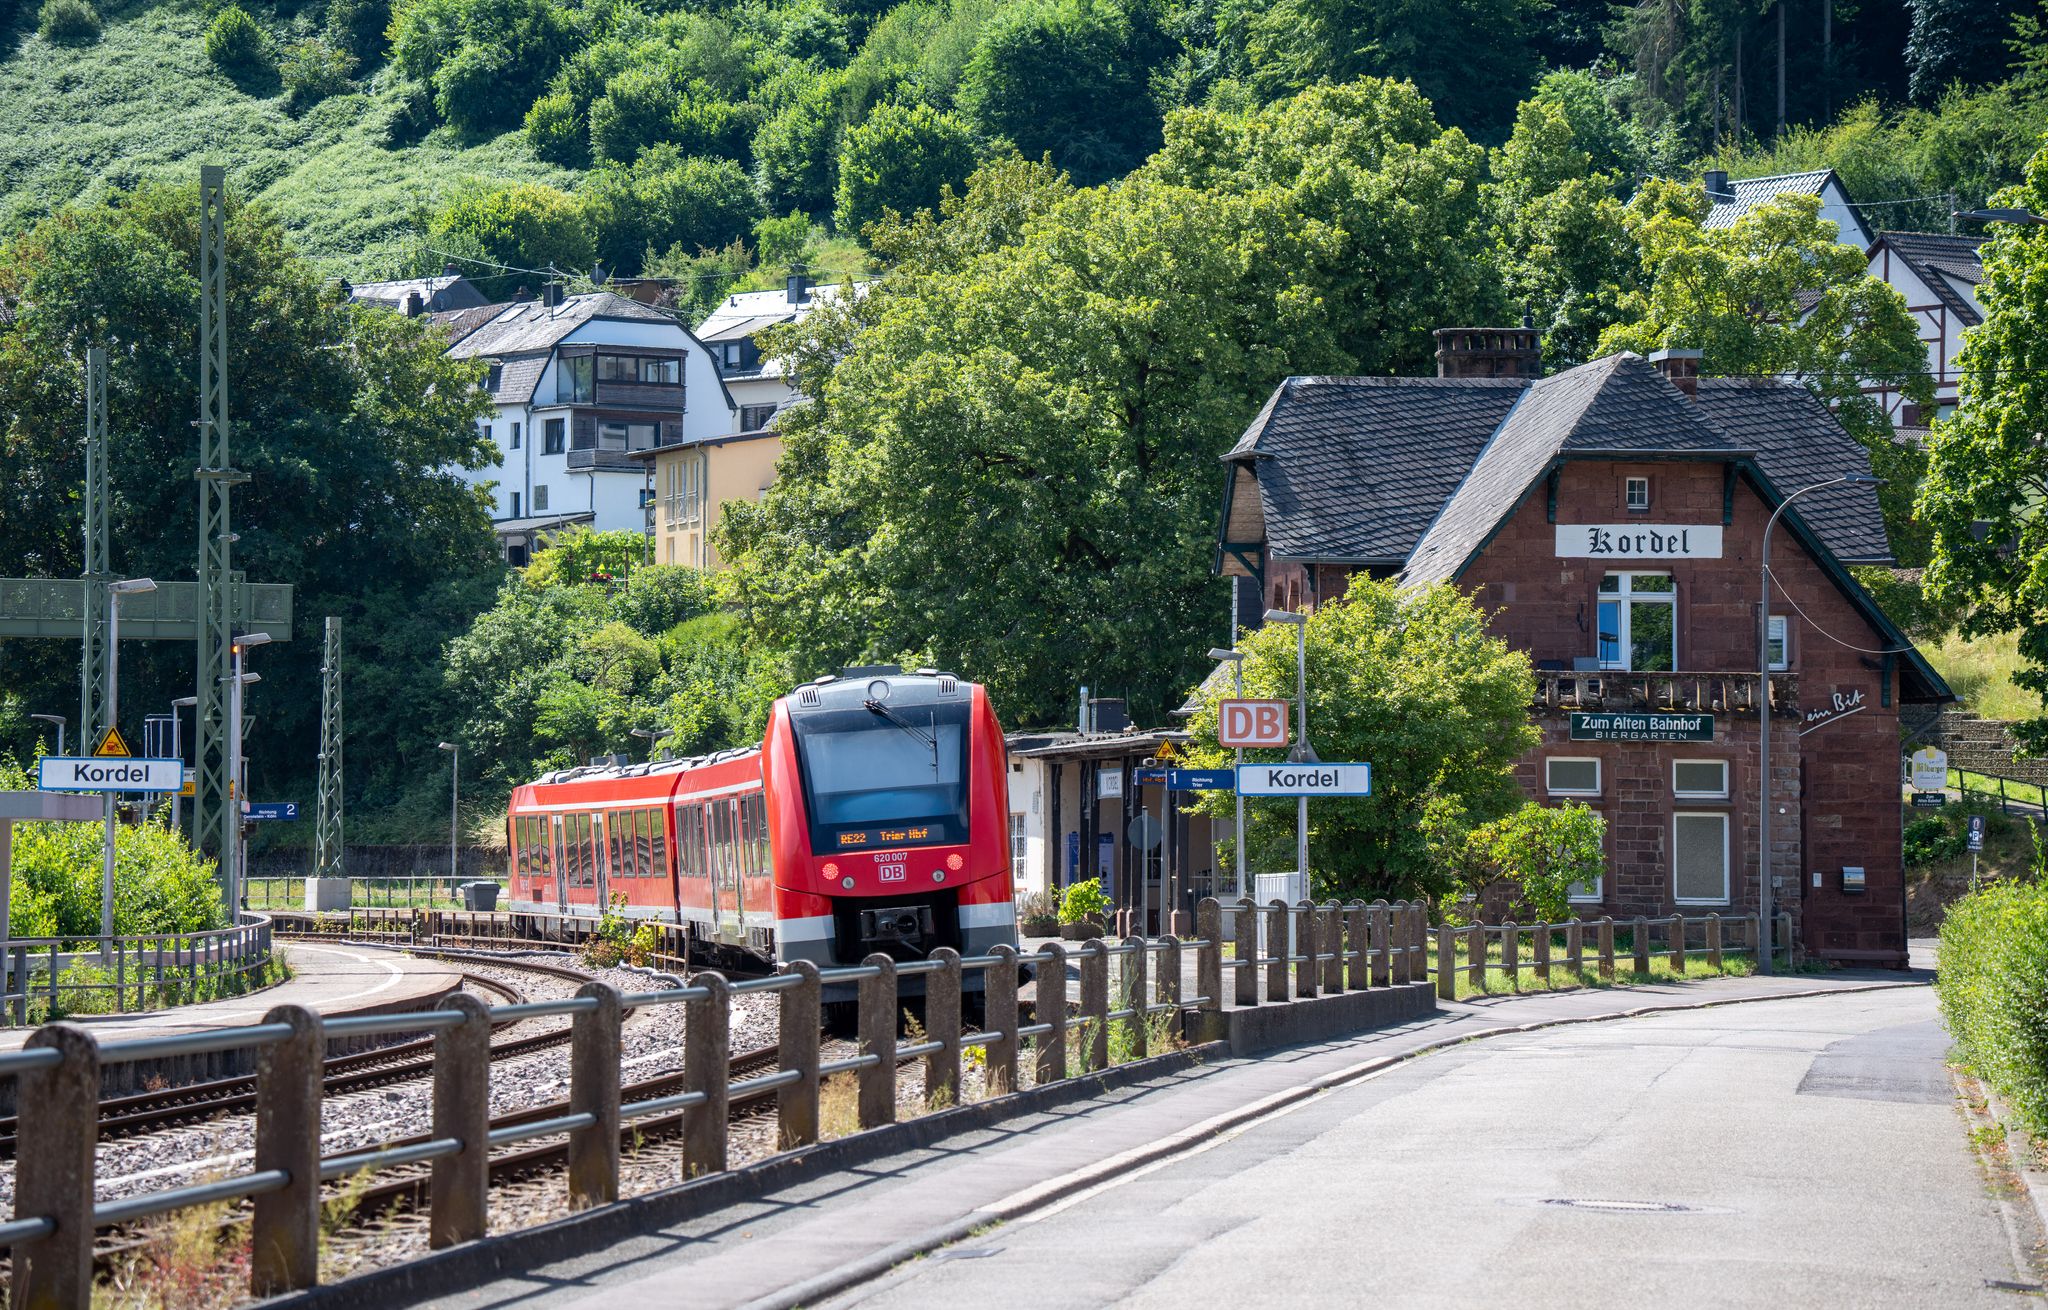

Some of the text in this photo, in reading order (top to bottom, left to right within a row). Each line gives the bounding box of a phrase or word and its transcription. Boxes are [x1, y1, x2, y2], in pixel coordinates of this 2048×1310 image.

[1588, 527, 1692, 554] Kordel
[1806, 689, 1865, 721] ein Bit
[1227, 706, 1281, 739] DB
[1581, 716, 1702, 731] Zum Alten Bahnhof
[1595, 731, 1688, 740] BIERGARTEN
[74, 763, 149, 782] Kordel
[1170, 771, 1177, 784] 1
[1268, 769, 1339, 787] Kordel
[286, 803, 295, 816] 2
[840, 828, 928, 844] RE22 Trier Hbf
[873, 852, 908, 863] 620 007
[881, 865, 904, 880] DB
